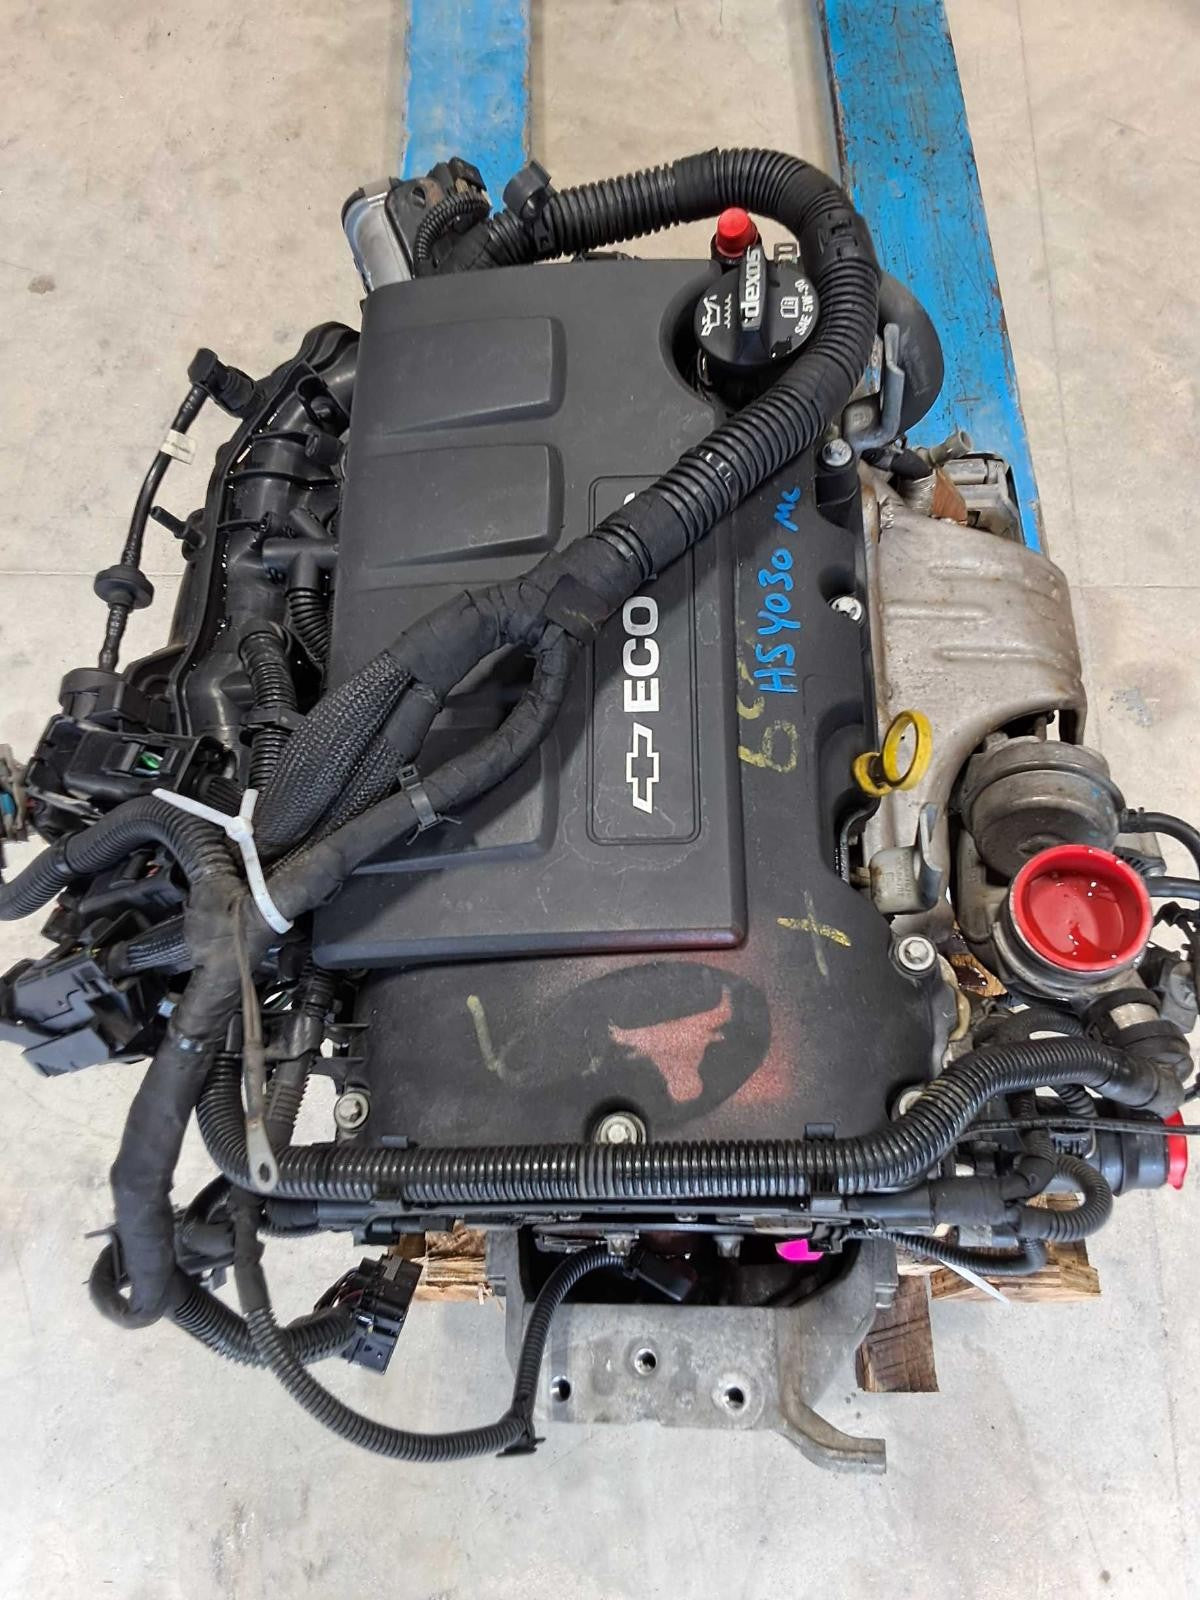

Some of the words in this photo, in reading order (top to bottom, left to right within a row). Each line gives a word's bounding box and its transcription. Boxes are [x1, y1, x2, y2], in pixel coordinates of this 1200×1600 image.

[741, 245, 760, 318] dexos
[795, 279, 814, 312] 5W-30
[795, 313, 812, 335] SAE
[622, 596, 660, 713] ECO
